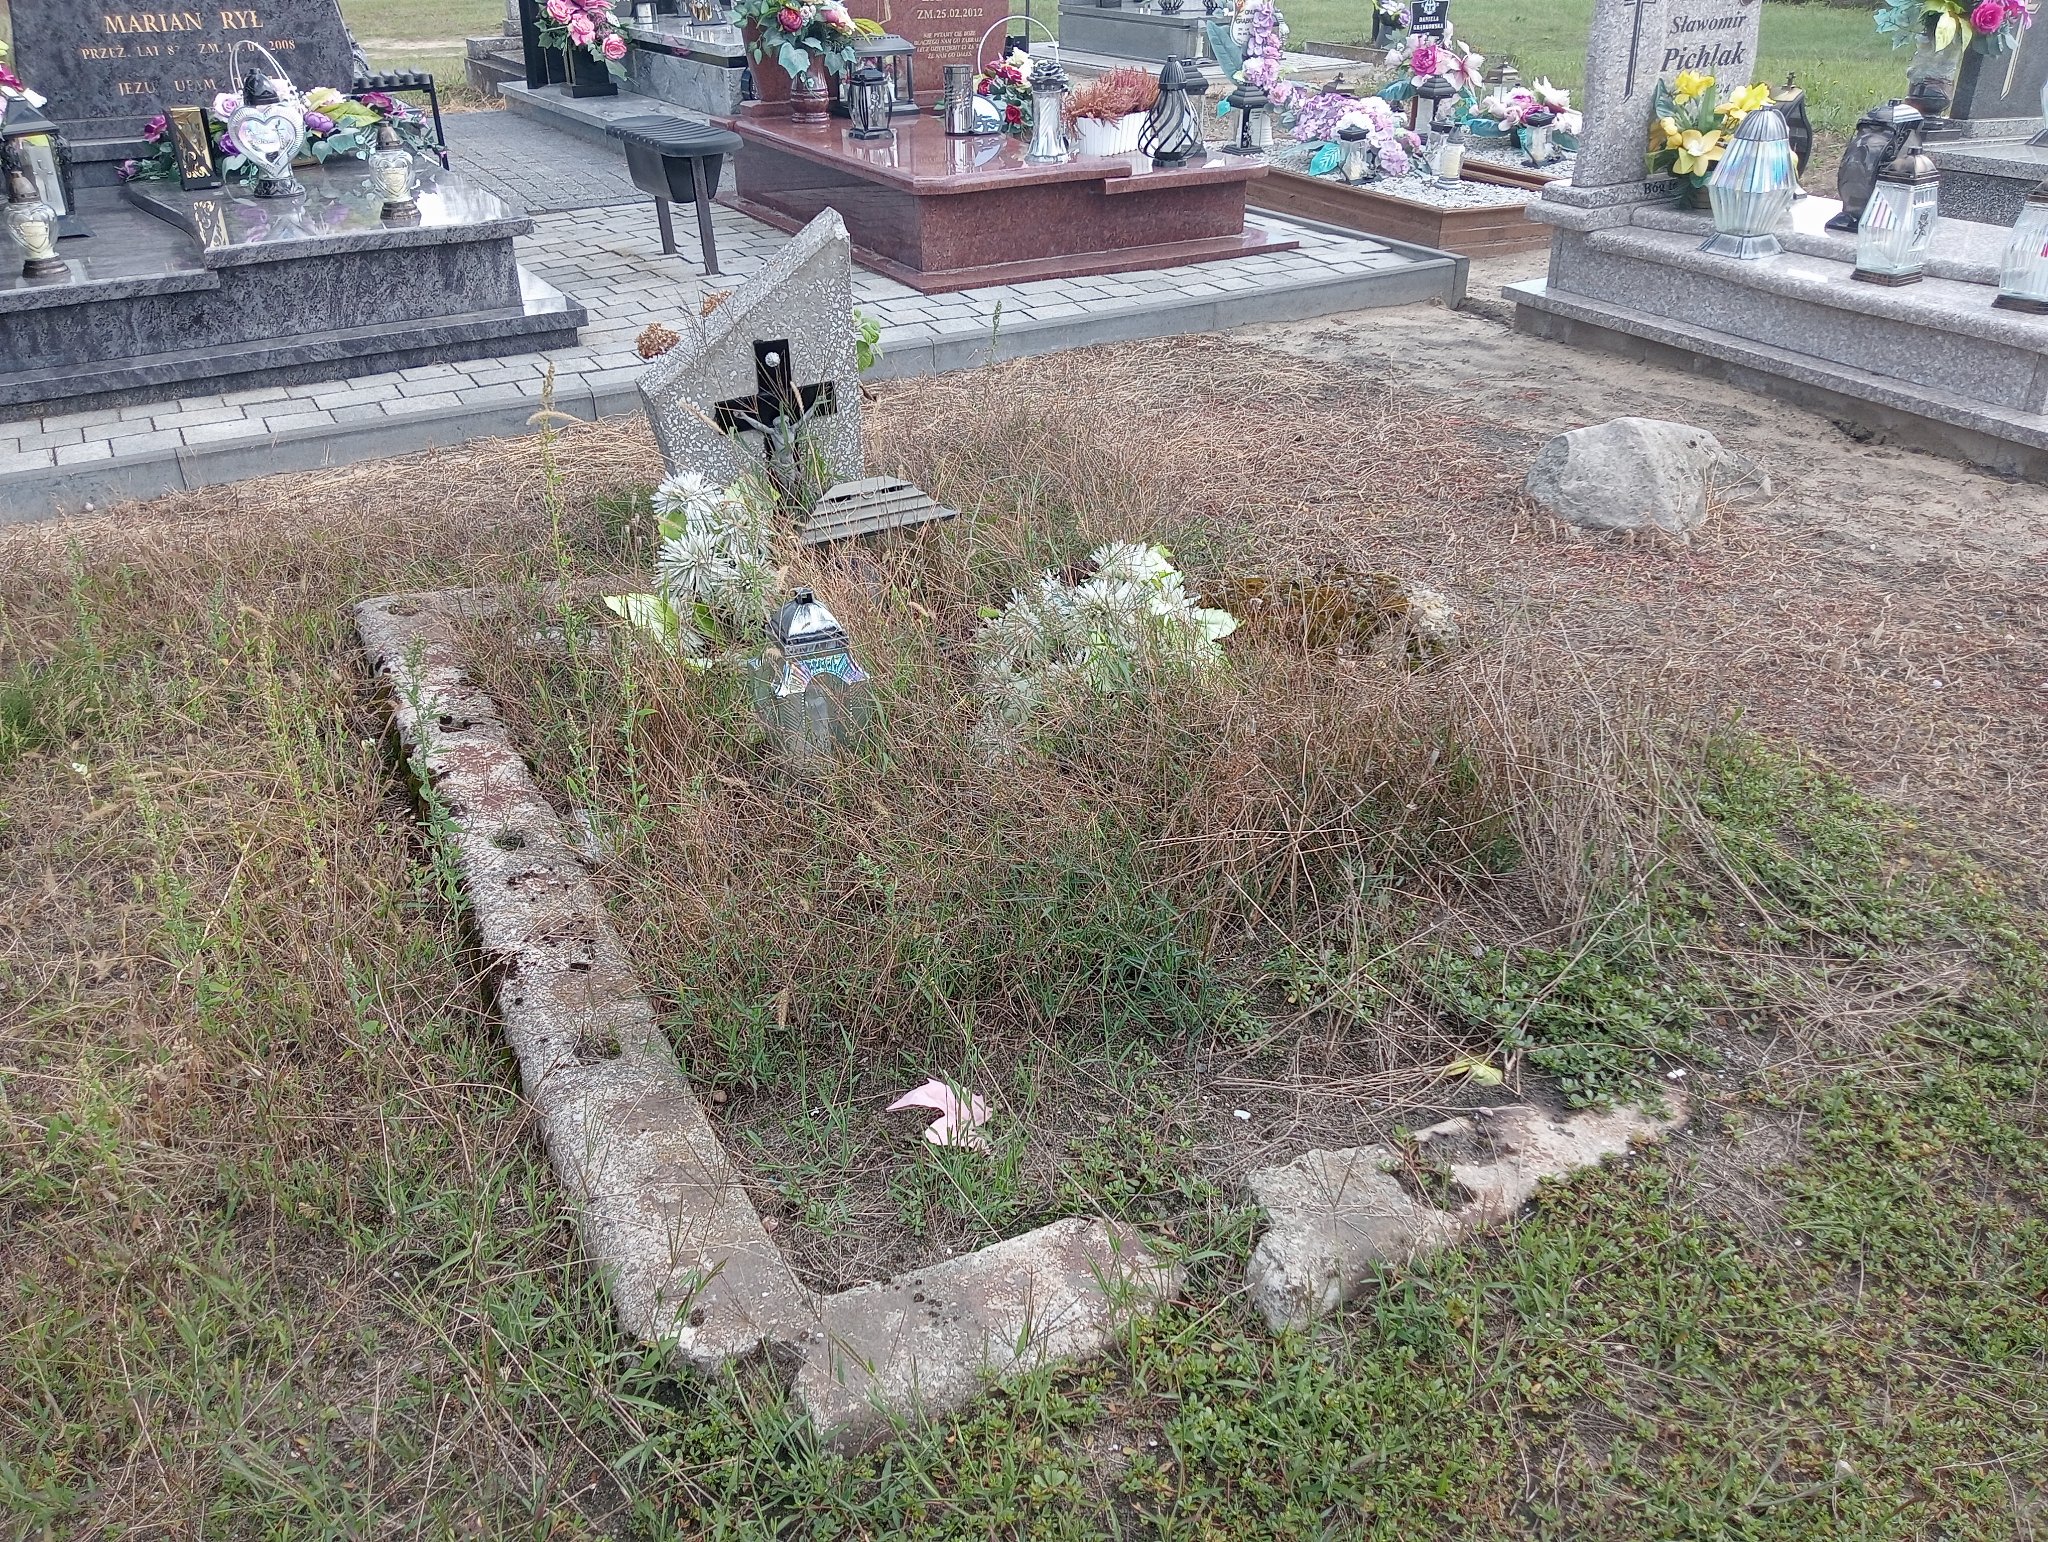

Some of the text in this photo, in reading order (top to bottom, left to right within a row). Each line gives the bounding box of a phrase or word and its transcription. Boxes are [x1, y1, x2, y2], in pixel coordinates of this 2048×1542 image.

[104, 10, 264, 34] MARIAN RYŁ
[916, 8, 983, 19] ZM.25.02.2012
[1669, 11, 1748, 34] Sławomir
[268, 40, 296, 51] 2008
[1660, 41, 1746, 72] Pichlak
[119, 82, 155, 96] JEZU
